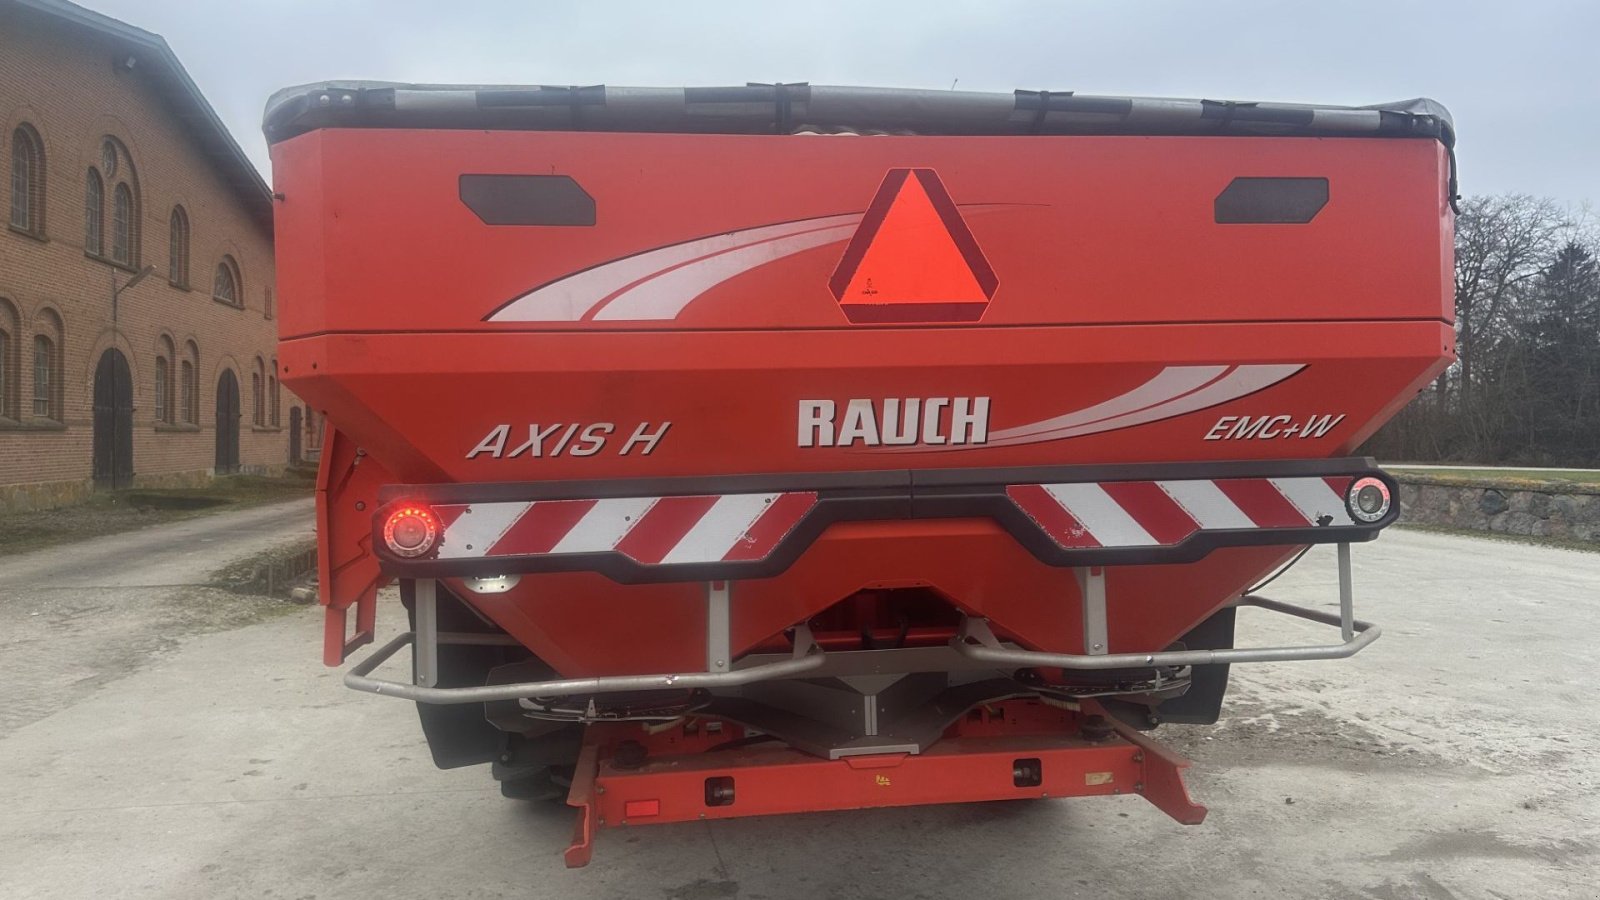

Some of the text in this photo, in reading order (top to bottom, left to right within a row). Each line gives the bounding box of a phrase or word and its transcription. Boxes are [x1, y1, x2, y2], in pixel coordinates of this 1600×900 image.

[465, 421, 672, 458] AXIS H
[797, 396, 991, 448] RAUCH
[1203, 413, 1347, 441] EMC+W
